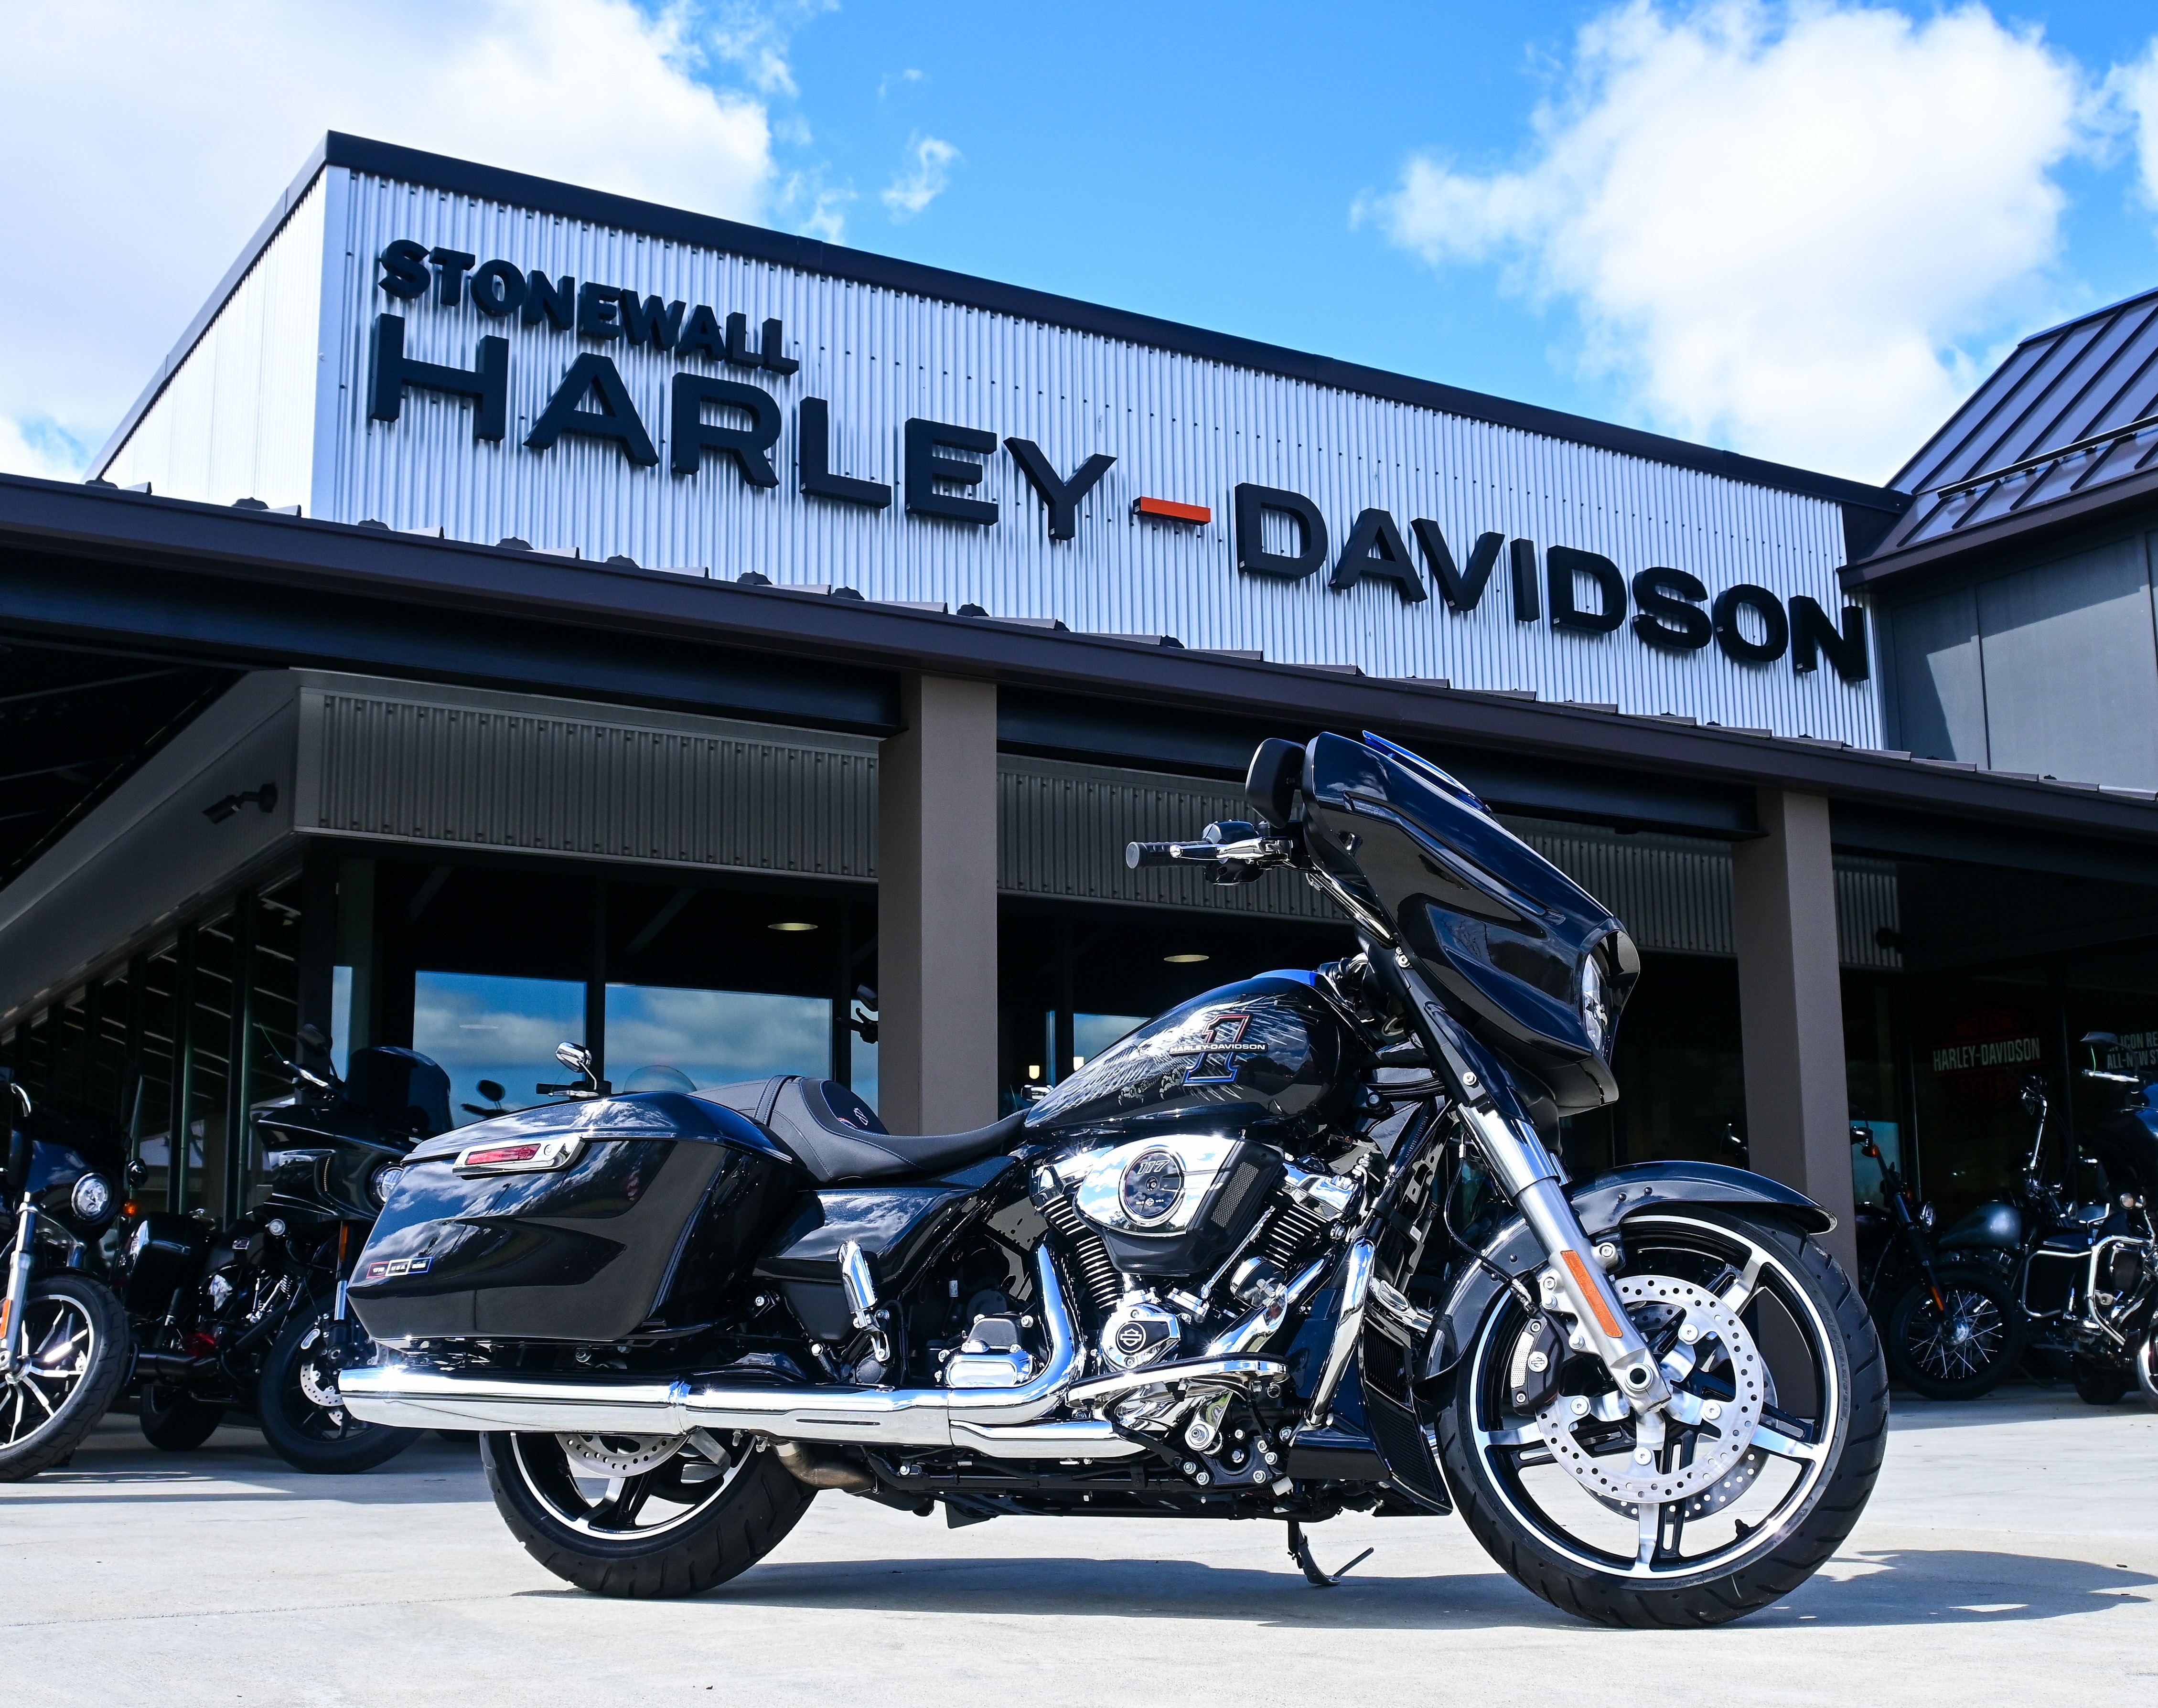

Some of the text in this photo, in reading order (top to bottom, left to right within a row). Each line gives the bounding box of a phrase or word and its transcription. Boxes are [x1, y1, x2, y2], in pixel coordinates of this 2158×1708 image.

[377, 239, 800, 375] STONEWALL
[1170, 1044, 1266, 1053] HARLEY-DAVIDSON
[1933, 1036, 2041, 1071] HARLEY-DAVIDSON
[2107, 1050, 2148, 1070] ALL-NW
[1137, 1160, 1170, 1174] 117
